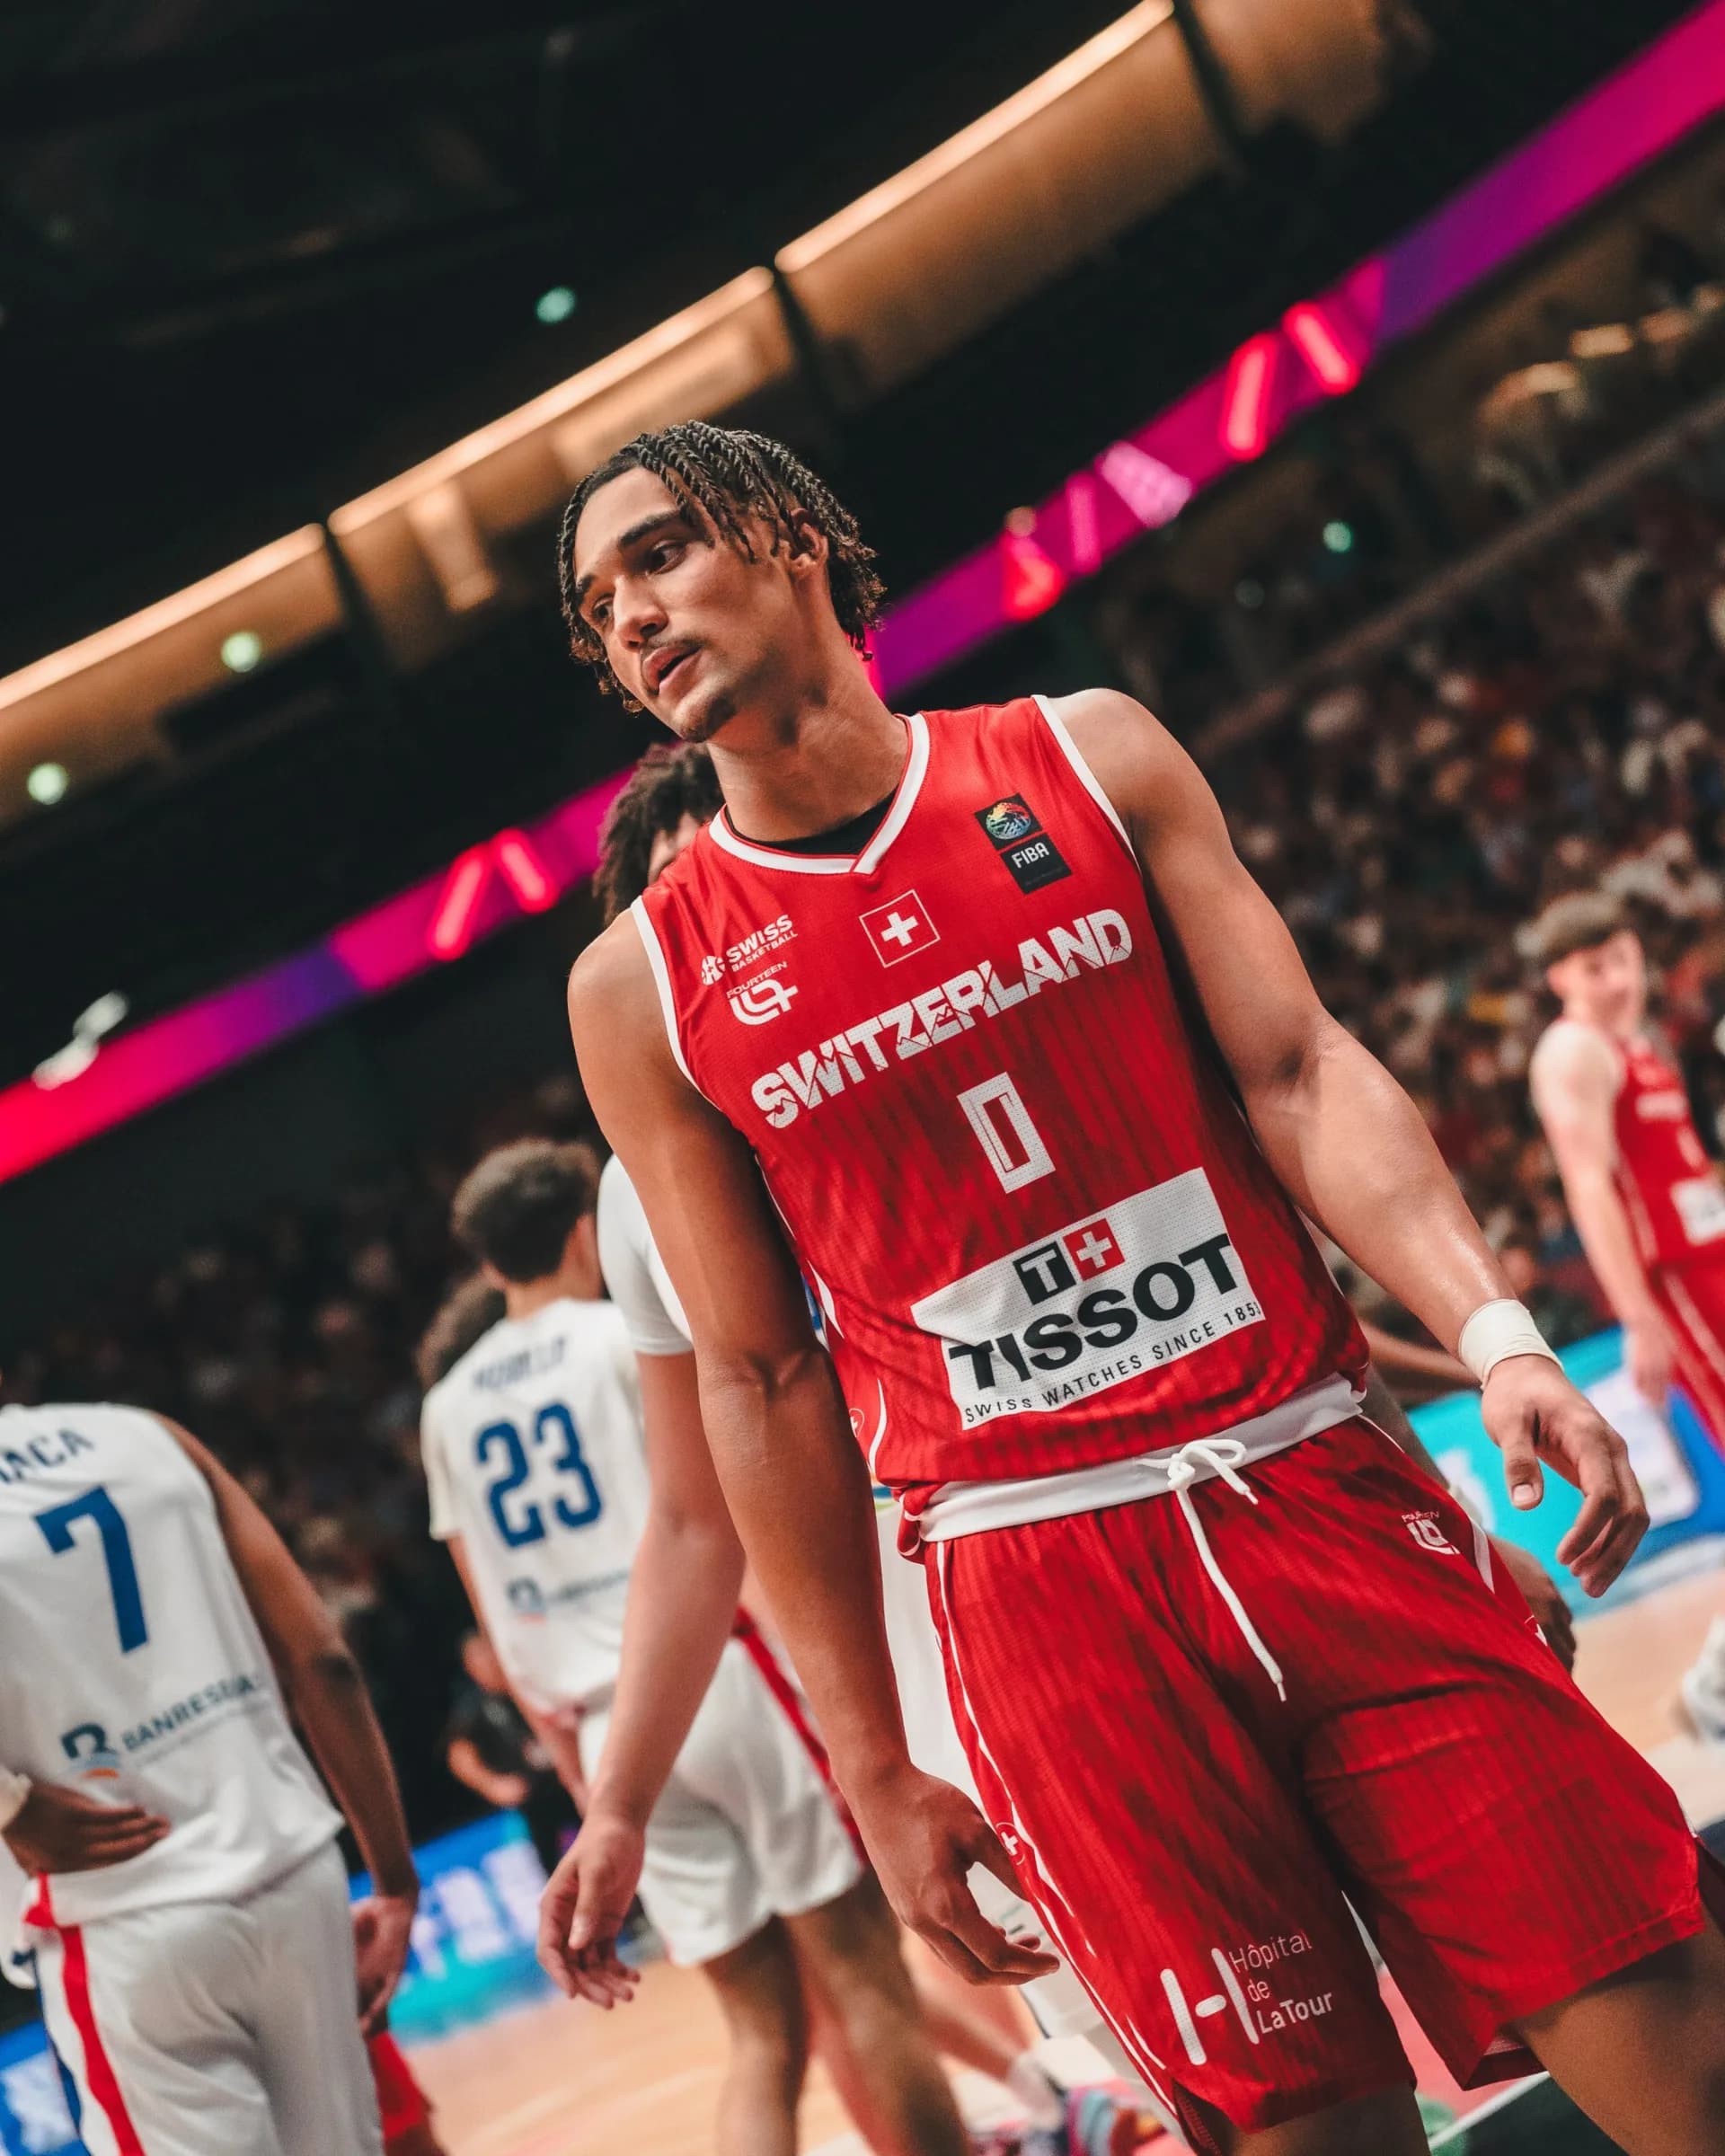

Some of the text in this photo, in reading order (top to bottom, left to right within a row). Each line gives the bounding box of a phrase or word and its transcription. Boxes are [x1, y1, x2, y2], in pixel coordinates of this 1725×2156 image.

[1011, 842, 1049, 868] FIBA
[725, 914, 793, 963] SWISS
[731, 930, 799, 972] BASKETBALL
[726, 960, 788, 999] FOURTEEN
[750, 908, 1133, 1129] SWITZERLAND
[956, 1071, 1057, 1194] 0
[949, 1233, 1238, 1391] TISSOT
[965, 1398, 1032, 1423] SWISS
[1041, 1355, 1143, 1407] WATCHES
[1153, 1321, 1216, 1361] SINCE
[473, 1401, 603, 1548] 23
[33, 1485, 149, 1654] 7
[1229, 1931, 1313, 1974] Hôpital
[1247, 1979, 1271, 2002] de
